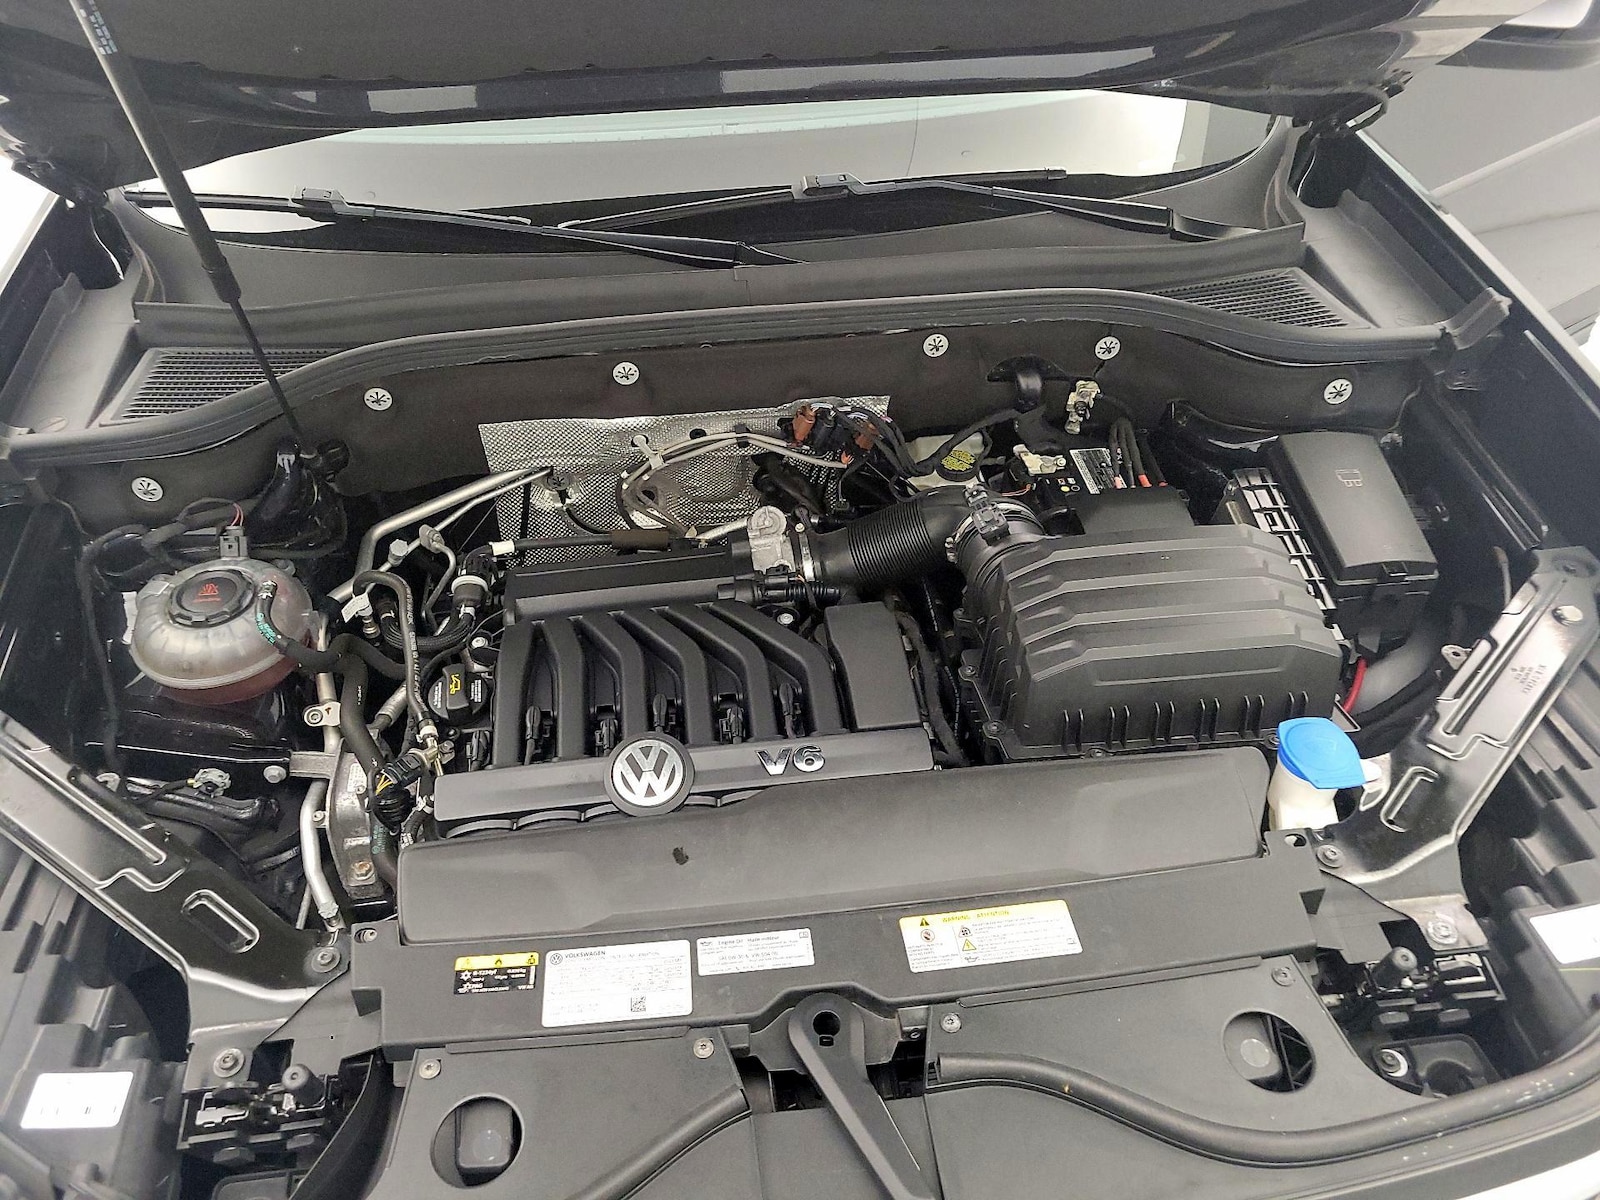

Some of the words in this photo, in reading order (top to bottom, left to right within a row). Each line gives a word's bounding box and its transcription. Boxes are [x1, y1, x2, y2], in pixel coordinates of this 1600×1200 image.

[612, 739, 684, 807] VW
[755, 745, 826, 776] V6
[564, 950, 606, 958] VOLKSWAGEN
